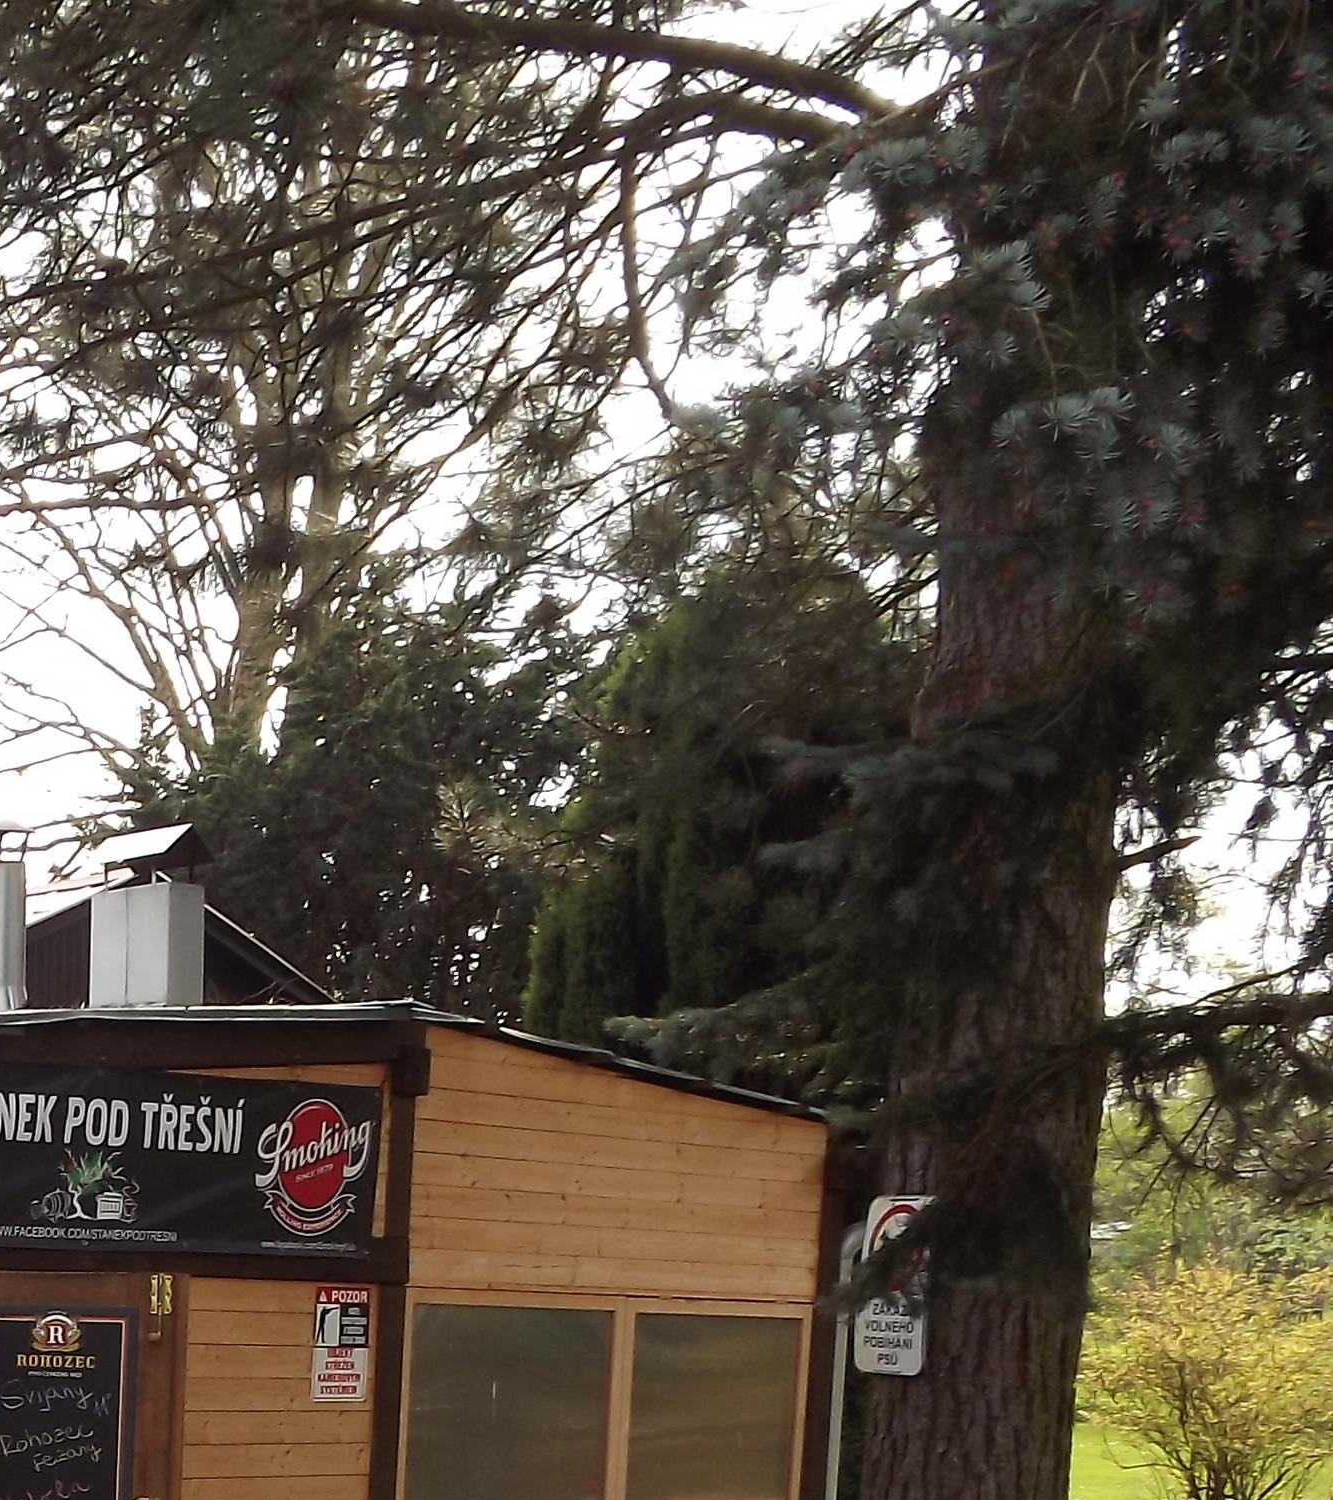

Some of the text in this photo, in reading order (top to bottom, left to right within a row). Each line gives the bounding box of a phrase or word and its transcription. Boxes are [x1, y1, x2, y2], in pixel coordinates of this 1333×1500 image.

[63, 1097, 130, 1147] POD
[140, 1093, 246, 1155] TŘEŠNÍ
[255, 1120, 372, 1187] Smoking
[331, 1290, 368, 1304] POZOR
[47, 1325, 65, 1344] R
[16, 1354, 96, 1369] ROHOZEC
